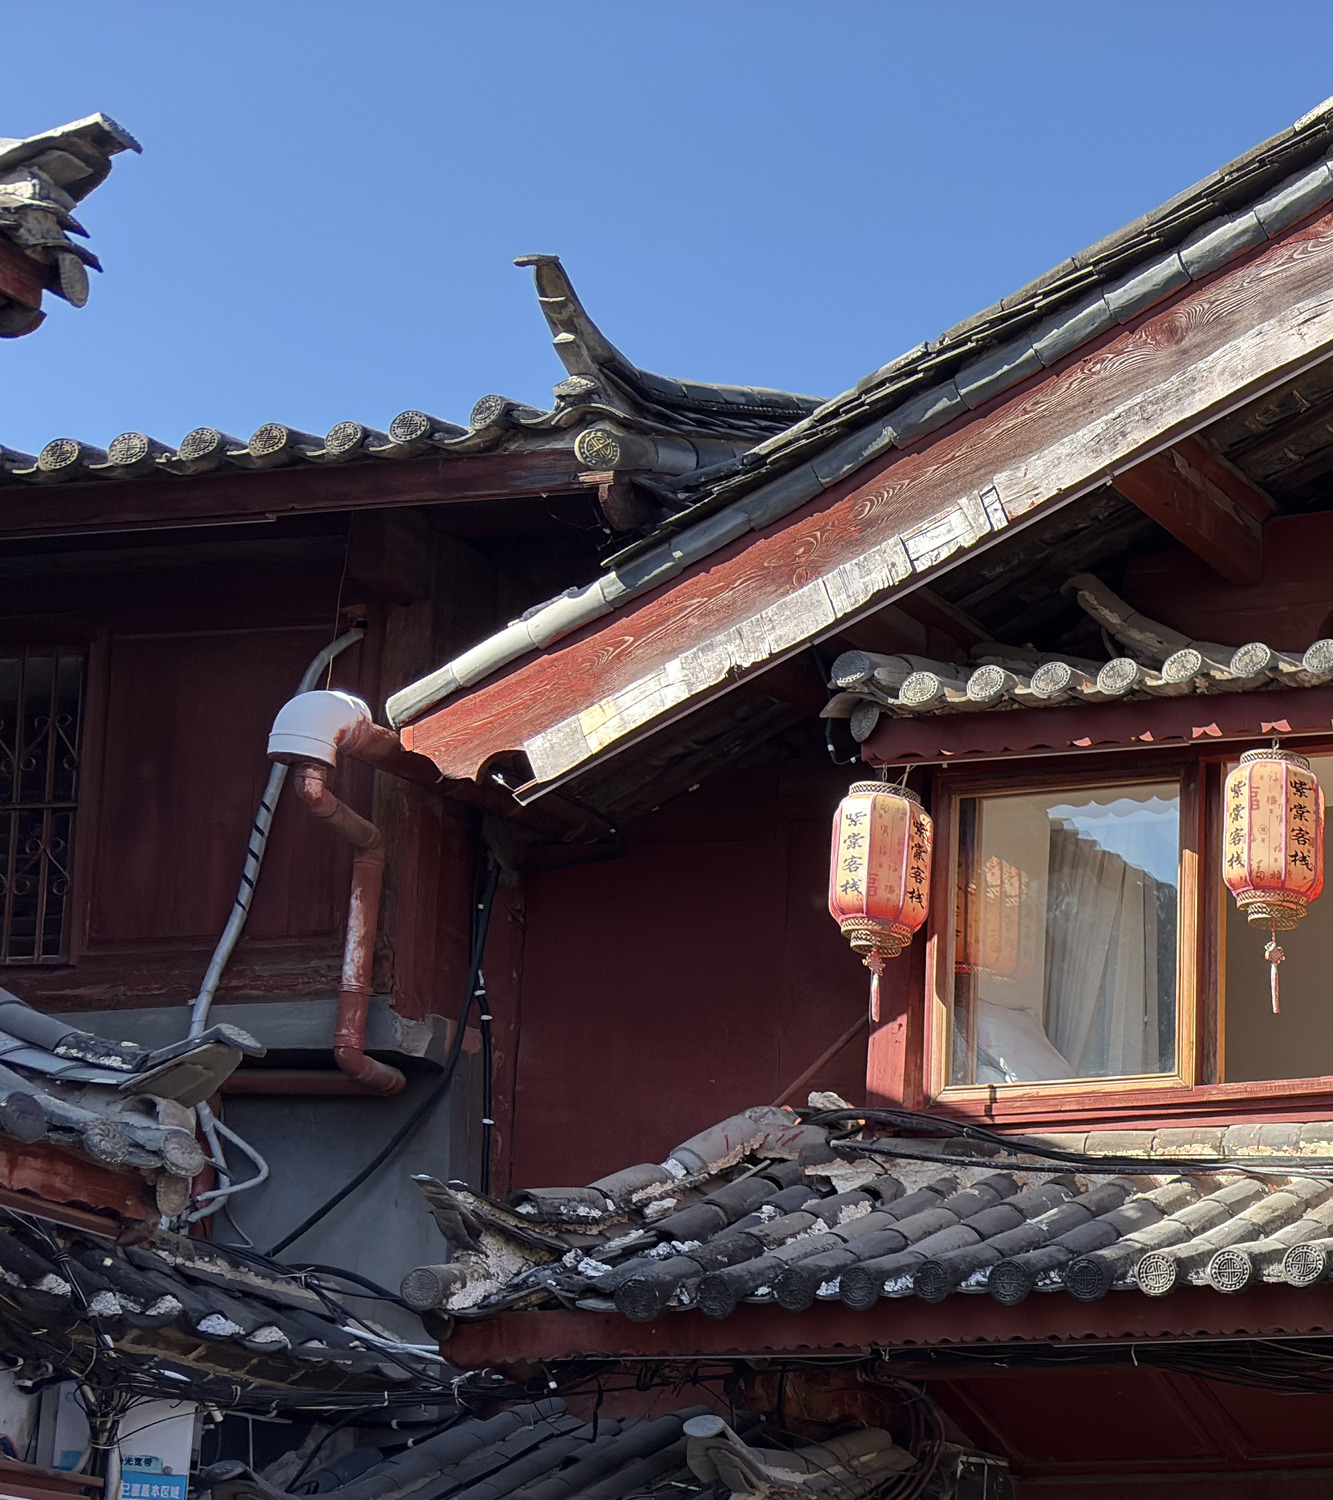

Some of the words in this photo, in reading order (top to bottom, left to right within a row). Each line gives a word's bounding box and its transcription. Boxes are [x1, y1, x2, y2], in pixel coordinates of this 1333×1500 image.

[839, 811, 867, 896] 紫棠客栈
[906, 818, 929, 910] 紫棠客栈
[1227, 780, 1247, 870] 紫棠客栈
[1288, 780, 1314, 872] 紫棠客栈
